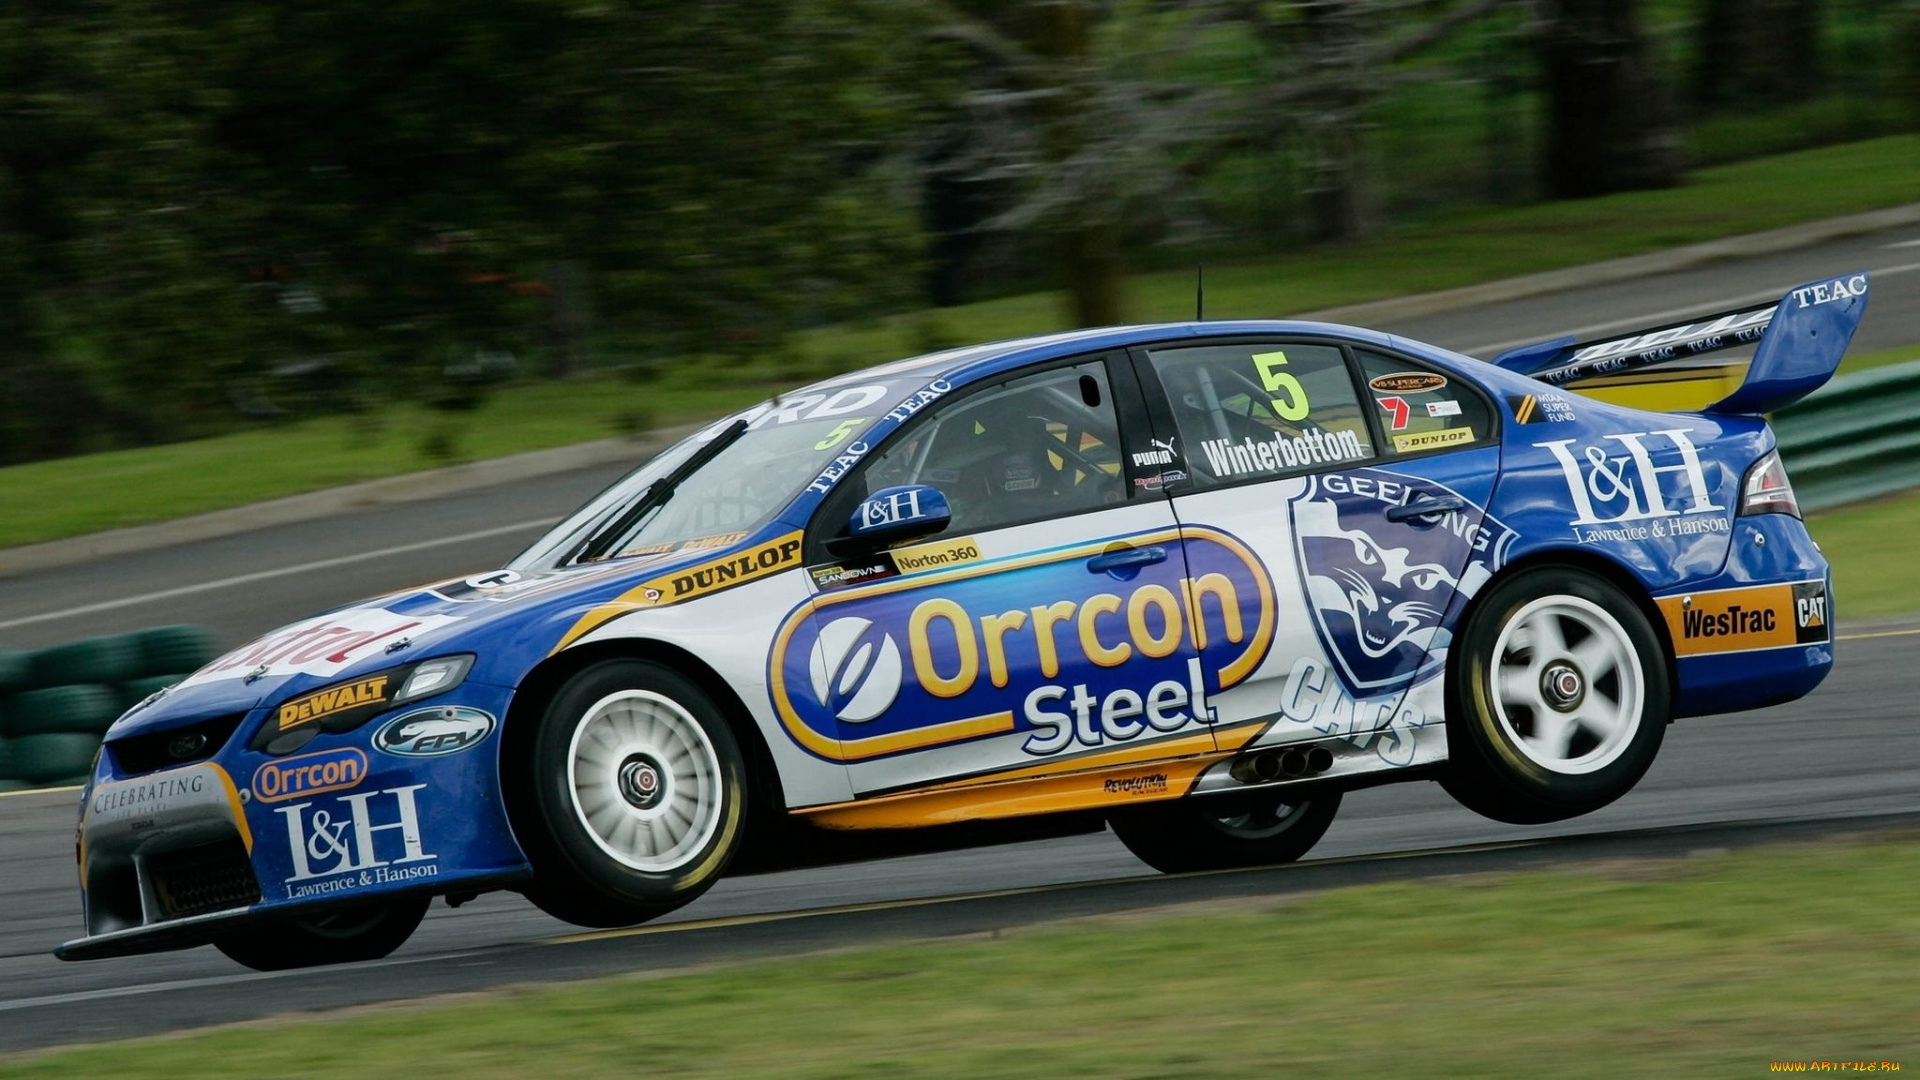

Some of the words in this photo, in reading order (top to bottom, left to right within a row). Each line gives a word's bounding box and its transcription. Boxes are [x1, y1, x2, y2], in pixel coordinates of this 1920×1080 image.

[1793, 274, 1868, 308] TEAC
[1640, 346, 1675, 363] TEAC
[1688, 336, 1723, 352] TEAC
[1546, 366, 1581, 383] TEAC
[1593, 356, 1627, 373] TEAC
[885, 378, 952, 424] TEAC
[1251, 351, 1310, 421] 5
[698, 386, 887, 443] ORD
[1543, 403, 1571, 412] SUPER
[1548, 412, 1576, 422] FUND
[814, 419, 866, 451] 5
[1411, 432, 1466, 446] DUNLOP
[806, 440, 869, 494] TEAC
[1132, 450, 1172, 467] PUMA
[1201, 427, 1363, 477] Winterbottom
[1574, 526, 1647, 544] Lawrence
[1651, 518, 1665, 537] &
[1669, 515, 1730, 536] Hanson
[672, 539, 801, 597] DUNLOP
[898, 552, 949, 570] Norton
[951, 546, 978, 562] 360
[1683, 605, 1776, 639] WesTrac
[1797, 597, 1825, 628] CAT
[908, 573, 1244, 698] Orrcon
[1022, 658, 1217, 754] Steel
[259, 757, 359, 797] Orrcon
[1103, 774, 1168, 793] REVOLUTION
[286, 879, 355, 900] Lawrence
[358, 869, 373, 887] &
[374, 862, 438, 884] Hanson
